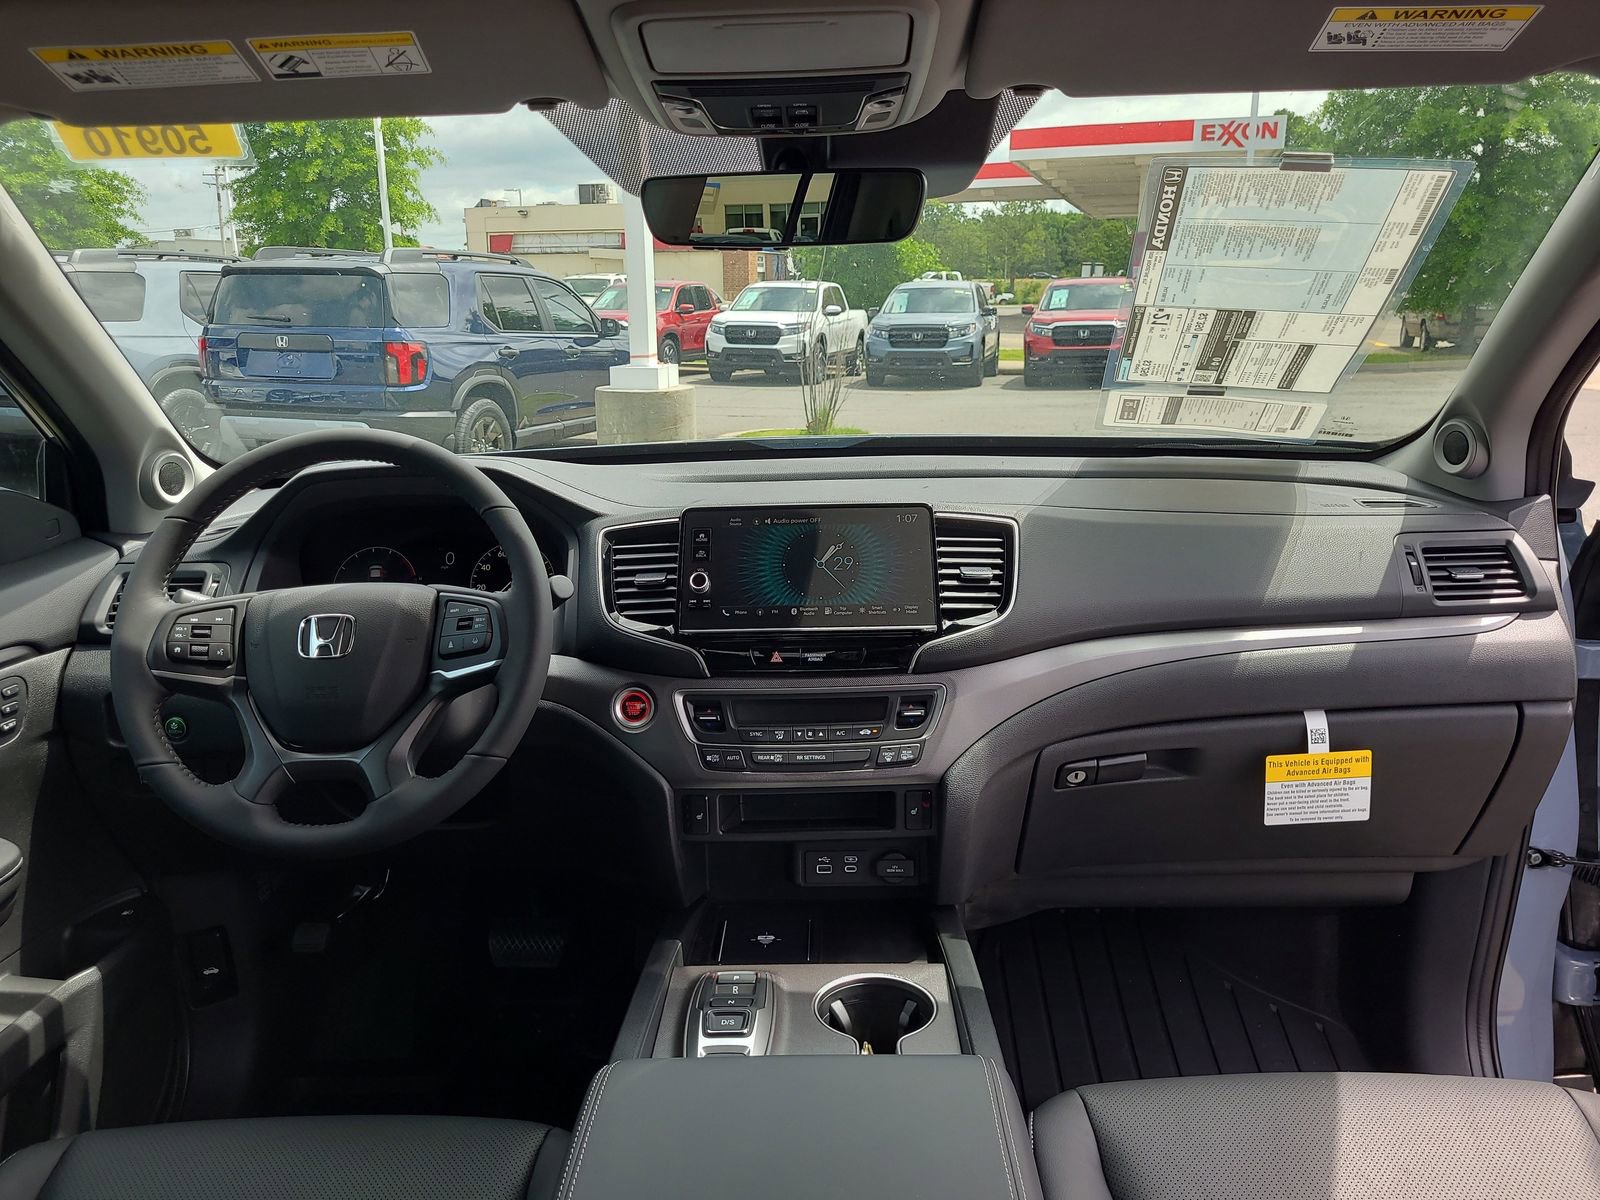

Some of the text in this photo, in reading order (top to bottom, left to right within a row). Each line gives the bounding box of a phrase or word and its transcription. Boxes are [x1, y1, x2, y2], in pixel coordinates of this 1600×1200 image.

[1394, 8, 1508, 19] WARNING
[271, 39, 332, 49] WARNING
[95, 44, 208, 60] WARNING
[1201, 120, 1278, 148] EXXON
[896, 513, 918, 523] 1:07
[446, 551, 455, 565] 0
[834, 556, 854, 570] 29
[1285, 759, 1311, 767] Vehicle
[1312, 758, 1319, 766] is
[1321, 757, 1353, 766] Equipped
[1355, 755, 1370, 763] with
[1286, 768, 1320, 777] Advanced
[1334, 766, 1351, 775] Bags
[732, 986, 738, 994] R
